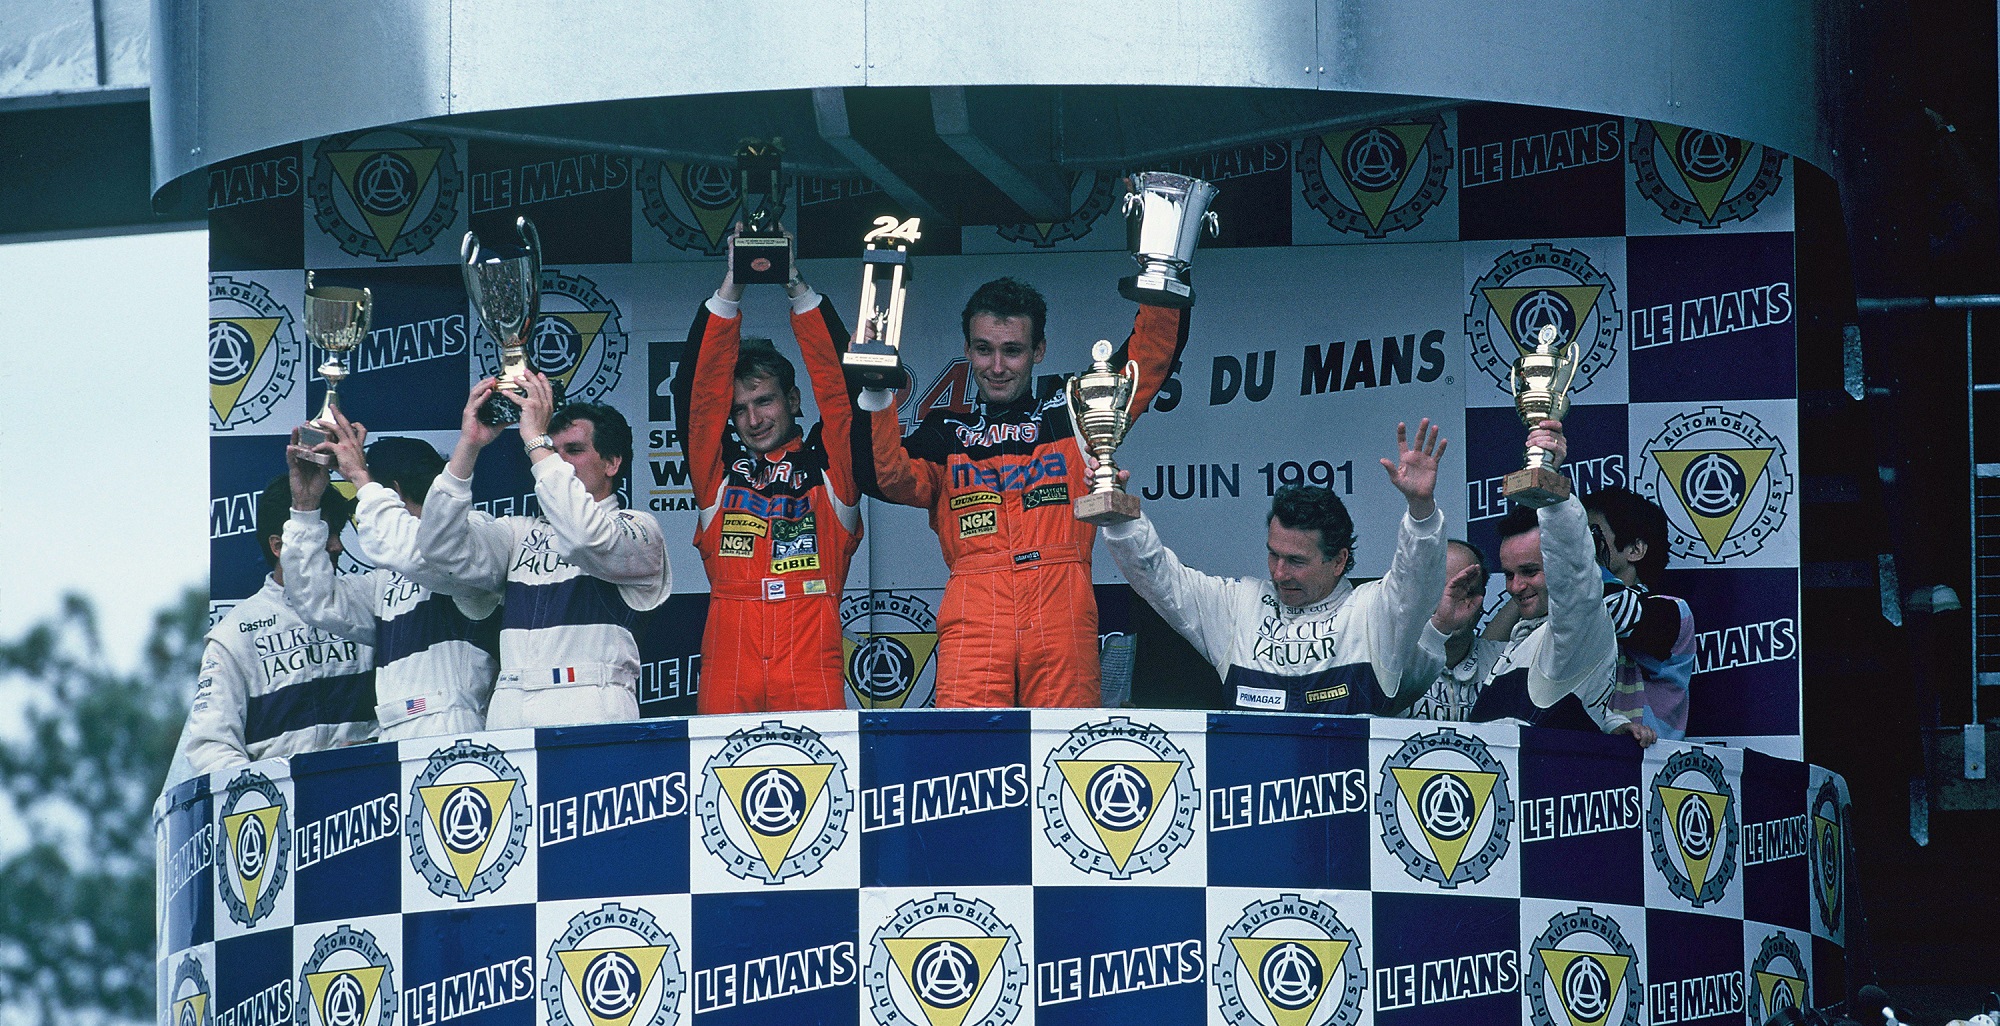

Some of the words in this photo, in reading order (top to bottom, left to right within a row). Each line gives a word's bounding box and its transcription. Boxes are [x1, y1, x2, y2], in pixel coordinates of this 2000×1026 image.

[1463, 142, 1503, 188] LE
[1511, 121, 1621, 179] MANS
[472, 169, 512, 214] LE
[520, 152, 630, 205] MANS
[1306, 157, 1329, 205] CLUB
[1337, 209, 1358, 225] DE
[1393, 153, 1443, 224] L'OUEST
[1639, 147, 1663, 196] CLUB
[1670, 200, 1691, 216] DE
[1728, 154, 1777, 214] L'OUES
[318, 183, 341, 226] CLUB
[350, 234, 370, 248] DE
[405, 177, 450, 247] L'OUEST
[863, 215, 922, 243] 24
[1494, 253, 1594, 284] AUTOMOBILE
[208, 286, 272, 314] MOBILE
[541, 280, 599, 308] MOBILE
[1632, 304, 1673, 350] LE
[1680, 283, 1793, 342] MANS
[357, 314, 467, 373] MANS
[1475, 318, 1497, 367] CLUB
[241, 342, 291, 418] L'OUEST
[1210, 350, 1277, 406] DU
[1300, 330, 1446, 396] MANS
[1663, 416, 1766, 446] AUTOMOBILE
[954, 495, 998, 505] DUNLOP
[1141, 463, 1240, 500] JUIN
[1257, 461, 1354, 497] 1991
[1467, 476, 1508, 522] LE
[724, 519, 766, 531] DUNLOP
[962, 512, 994, 530] NGK
[1675, 534, 1697, 550] DE
[1732, 478, 1783, 548] L'OUEST
[722, 536, 752, 550] NGK
[776, 538, 815, 554] RAYS
[239, 615, 277, 633] Castrol
[841, 600, 932, 628] UTOMOBILE
[1296, 614, 1338, 640] CUT
[1309, 602, 1330, 612] CUT
[254, 628, 307, 657] SILK
[261, 641, 358, 685] JAGUAR
[1252, 636, 1337, 666] JAGUAR
[1690, 619, 1796, 675] MANS
[639, 658, 680, 704] LE
[1239, 693, 1281, 705] PRIMAGAZ
[1308, 687, 1346, 702] momo
[427, 750, 508, 781] AUTOMOBILE
[725, 731, 824, 762] AUTOMOBILE
[1068, 727, 1171, 757] AUTOMOBILE
[1402, 737, 1490, 768] AUTOMOBILE
[1665, 755, 1724, 789] AUTOMOBILE
[540, 797, 577, 847] LE
[583, 772, 688, 836] MANS
[861, 784, 905, 833] LE
[911, 764, 1029, 824] MANS
[1210, 784, 1251, 832] LE
[1259, 769, 1368, 825] MANS
[1521, 799, 1554, 843] LE
[1560, 786, 1641, 837] MANS
[296, 825, 320, 871] LE
[324, 793, 400, 860] MANS
[412, 820, 430, 869] CLUB
[434, 873, 451, 889] DE
[482, 811, 524, 887] L'OUEST
[705, 801, 727, 850] CLUB
[734, 855, 756, 871] DE
[793, 796, 843, 869] L'OUEST
[1048, 793, 1072, 843] CLUB
[1079, 849, 1101, 866] DE
[1140, 794, 1190, 865] L'OUEST
[1384, 800, 1405, 849] CLUB
[1411, 857, 1431, 874] DE
[1464, 807, 1506, 875] L'OUEST
[1743, 822, 1764, 866] LE
[1766, 814, 1807, 862] MANS
[179, 823, 213, 889] MANS
[218, 850, 232, 896] CLUB
[232, 902, 244, 916] DE
[258, 837, 287, 912] L'OUEST
[1652, 817, 1669, 867] CLUB
[1673, 876, 1686, 892] DE
[1707, 826, 1734, 895] L'OUEST
[567, 913, 658, 946] AUTOMOBILE
[893, 903, 998, 933] AUTOMOBILE
[1241, 905, 1340, 935] AUTOMOBILE
[1547, 917, 1623, 949] AUTOMOBILE
[312, 932, 379, 968] AUTOMOBILE
[1038, 958, 1081, 1006] LE
[1089, 940, 1204, 998] MANS
[405, 981, 436, 1026] LE
[441, 956, 534, 1021] MANS
[695, 964, 736, 1014] LE
[743, 941, 857, 1004] MANS
[873, 972, 898, 1023] CLUB
[1223, 970, 1245, 1021] CLUB
[1376, 965, 1415, 1011] LE
[1422, 950, 1519, 1005] MANS
[1650, 982, 1676, 1026] LE
[1682, 971, 1744, 1020] MANS
[237, 979, 292, 1026] MANS
